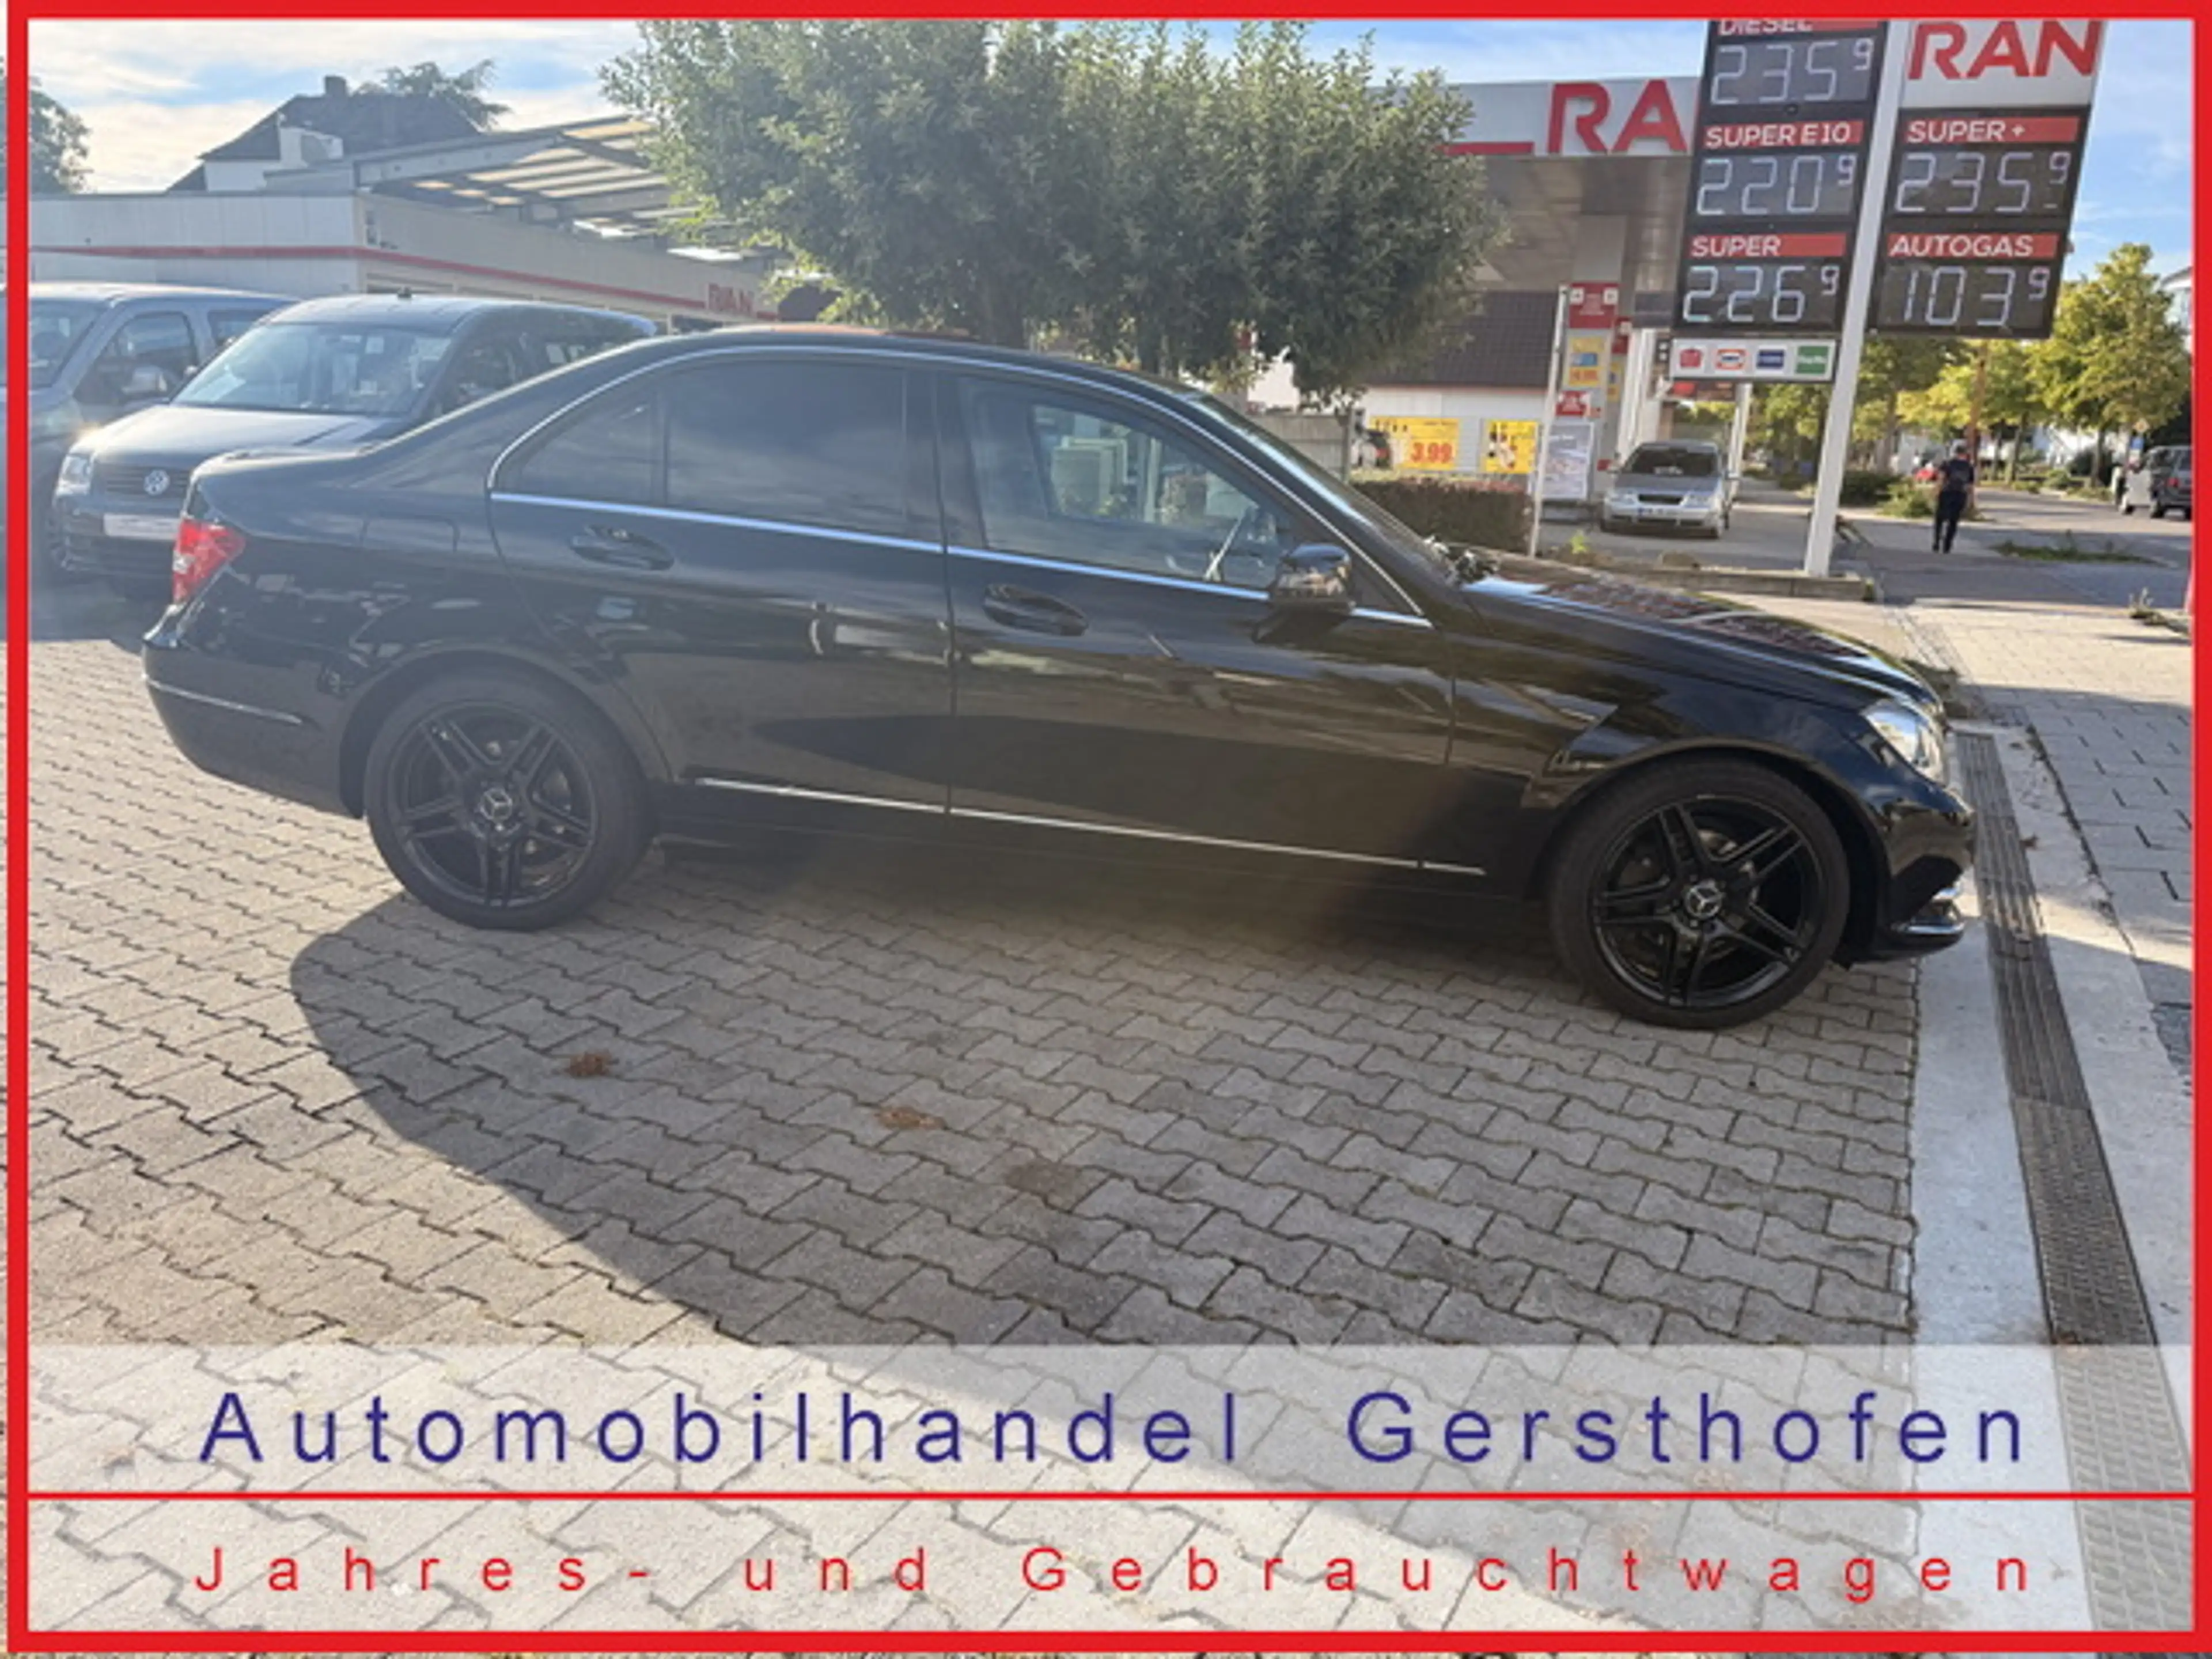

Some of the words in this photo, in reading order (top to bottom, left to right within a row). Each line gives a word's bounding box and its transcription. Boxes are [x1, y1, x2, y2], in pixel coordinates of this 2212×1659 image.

[1908, 20, 2103, 79] RAN
[1547, 78, 1701, 153] RA
[1706, 124, 1797, 149] SUPER
[1801, 121, 1851, 144] E10
[1907, 120, 2006, 143] SUPER
[1691, 235, 1782, 257] SUPER
[1888, 234, 2034, 257] AUTOGAS
